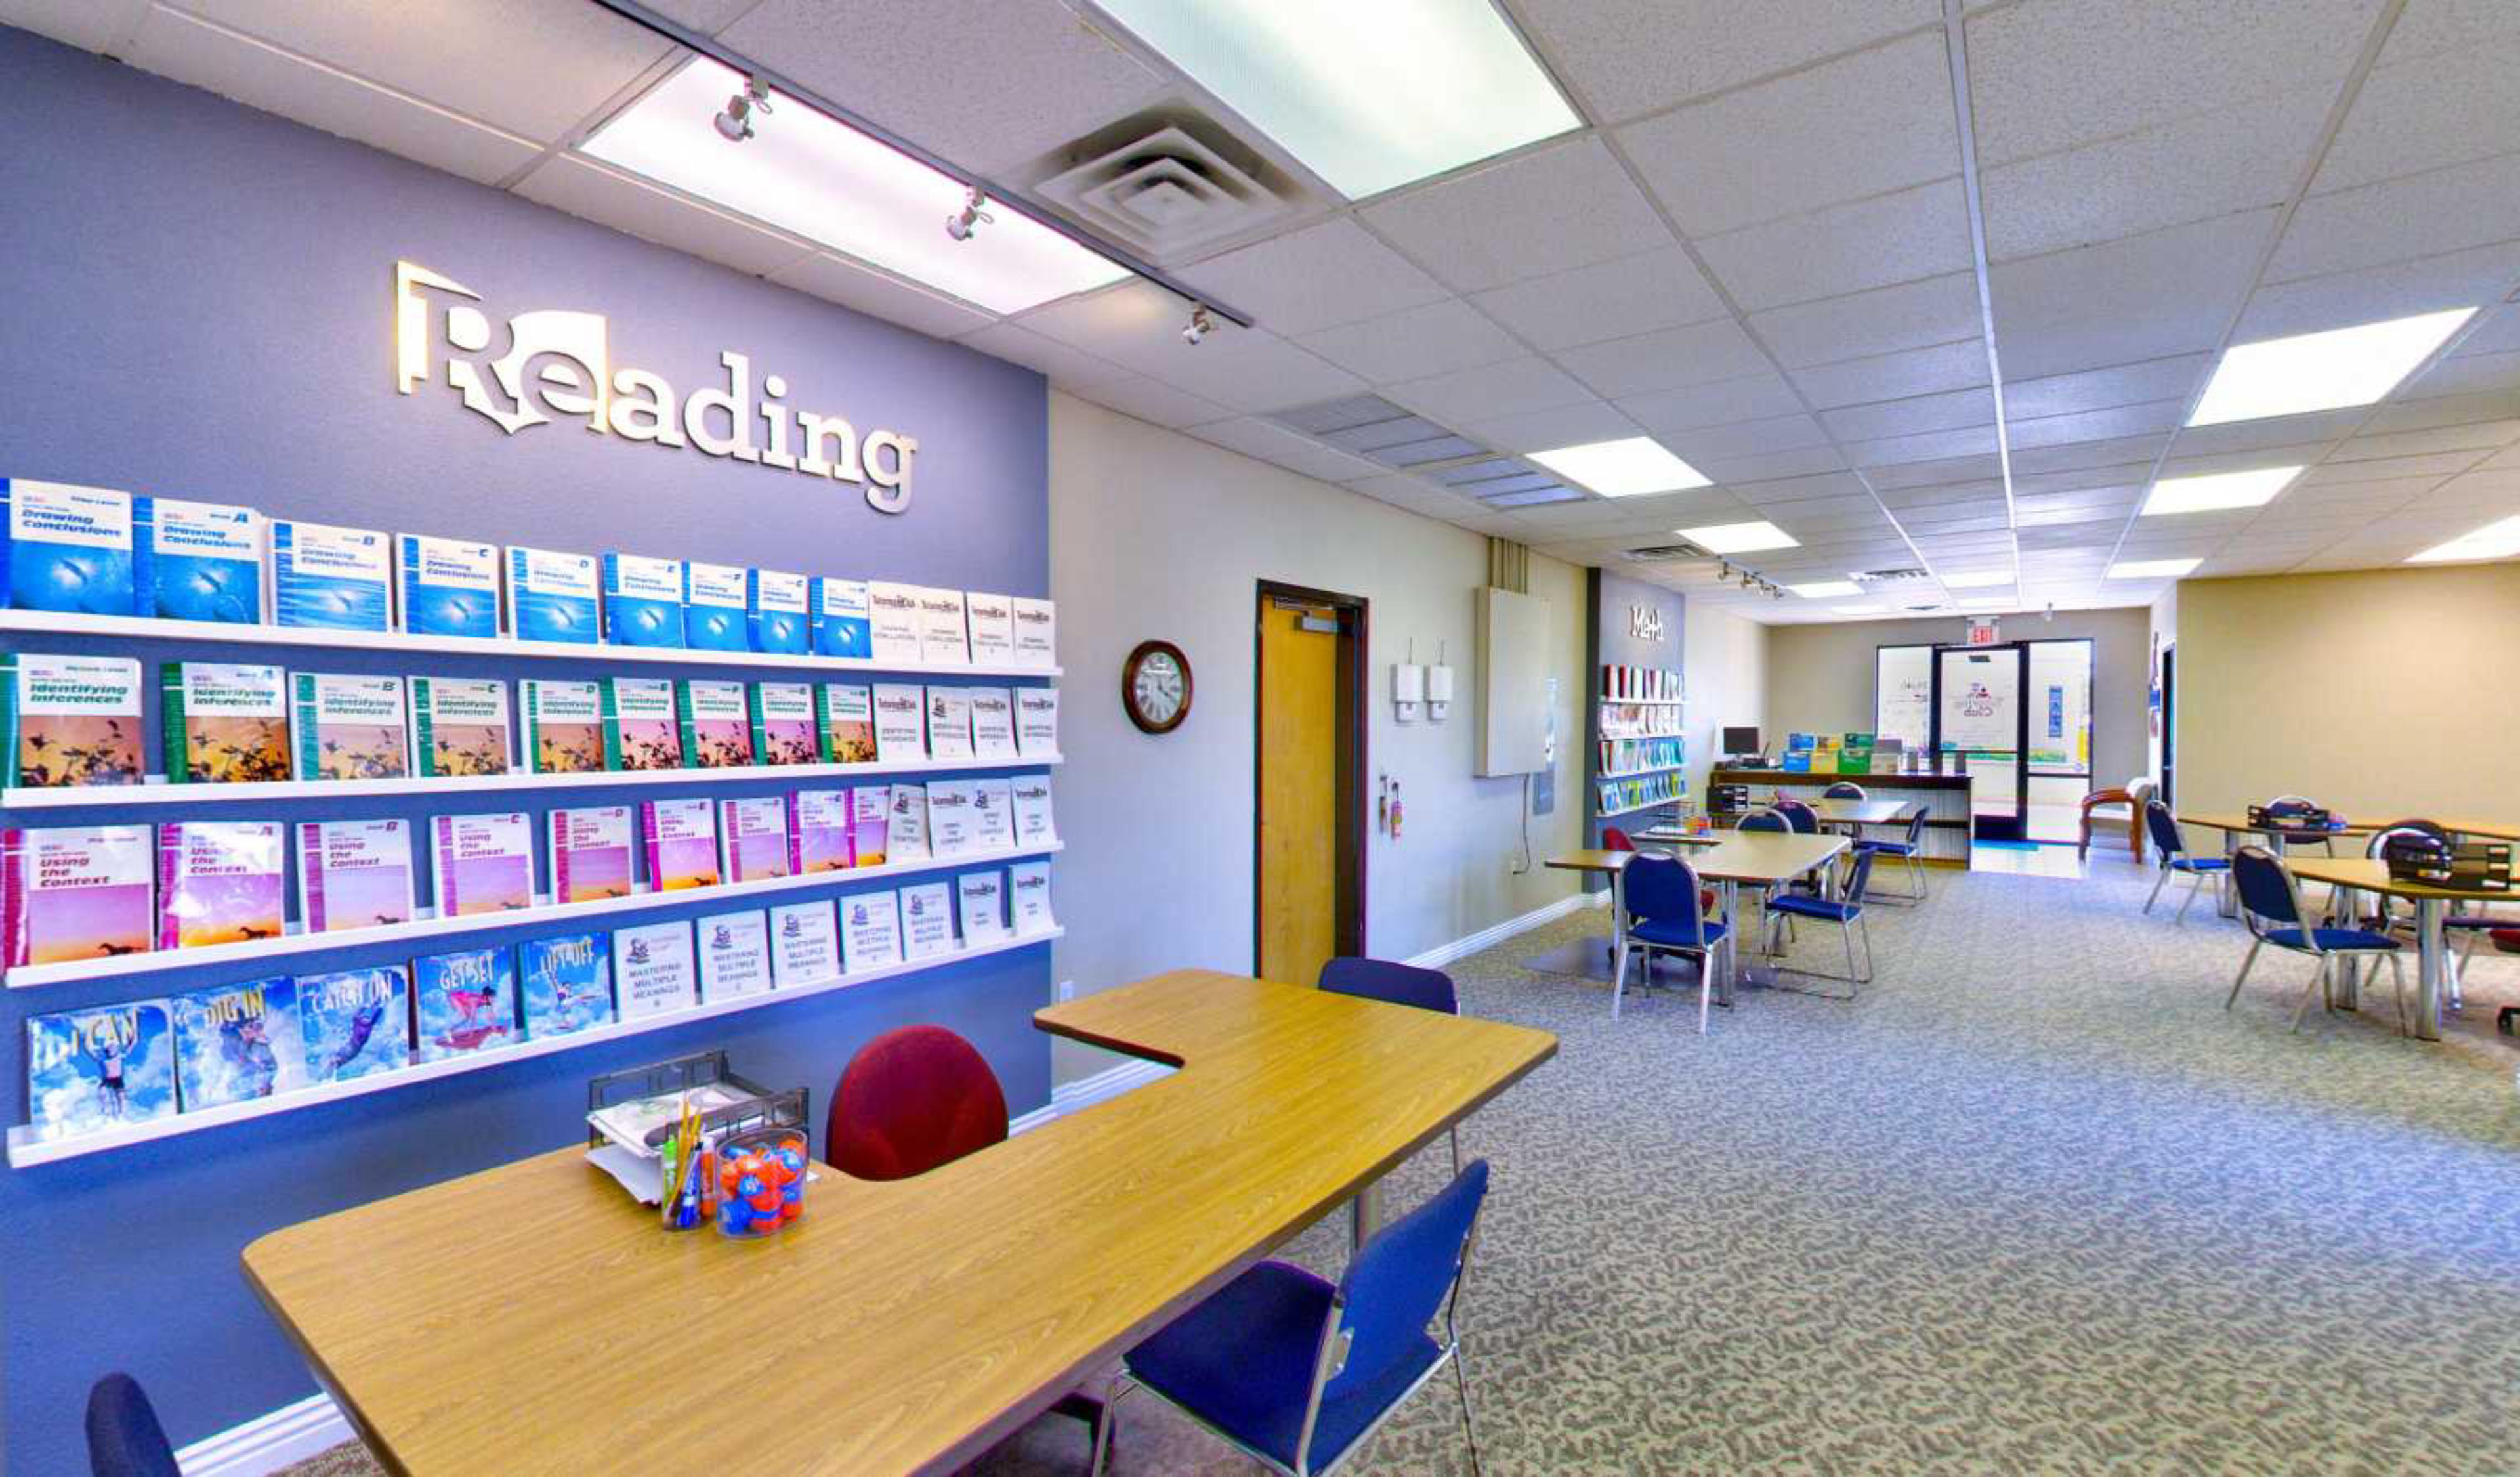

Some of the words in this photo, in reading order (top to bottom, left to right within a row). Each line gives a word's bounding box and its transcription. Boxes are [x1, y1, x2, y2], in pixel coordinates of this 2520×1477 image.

[396, 260, 919, 515] Reading
[22, 509, 93, 524] Drawing
[233, 511, 248, 523] A
[23, 519, 121, 536] Conclusions
[164, 526, 226, 539] Drawing
[164, 535, 251, 549] Conclusions
[479, 548, 489, 558] C
[1629, 605, 1665, 641] Math
[30, 683, 128, 695] Identifying
[383, 681, 396, 691] B
[488, 683, 497, 693] C
[30, 693, 123, 703] Inferences
[40, 858, 89, 867] Using
[41, 868, 70, 877] the
[41, 876, 110, 887] Context
[629, 962, 681, 978] MASTERING
[633, 974, 678, 988] MULTIPLE
[633, 985, 681, 999] MEANINGS
